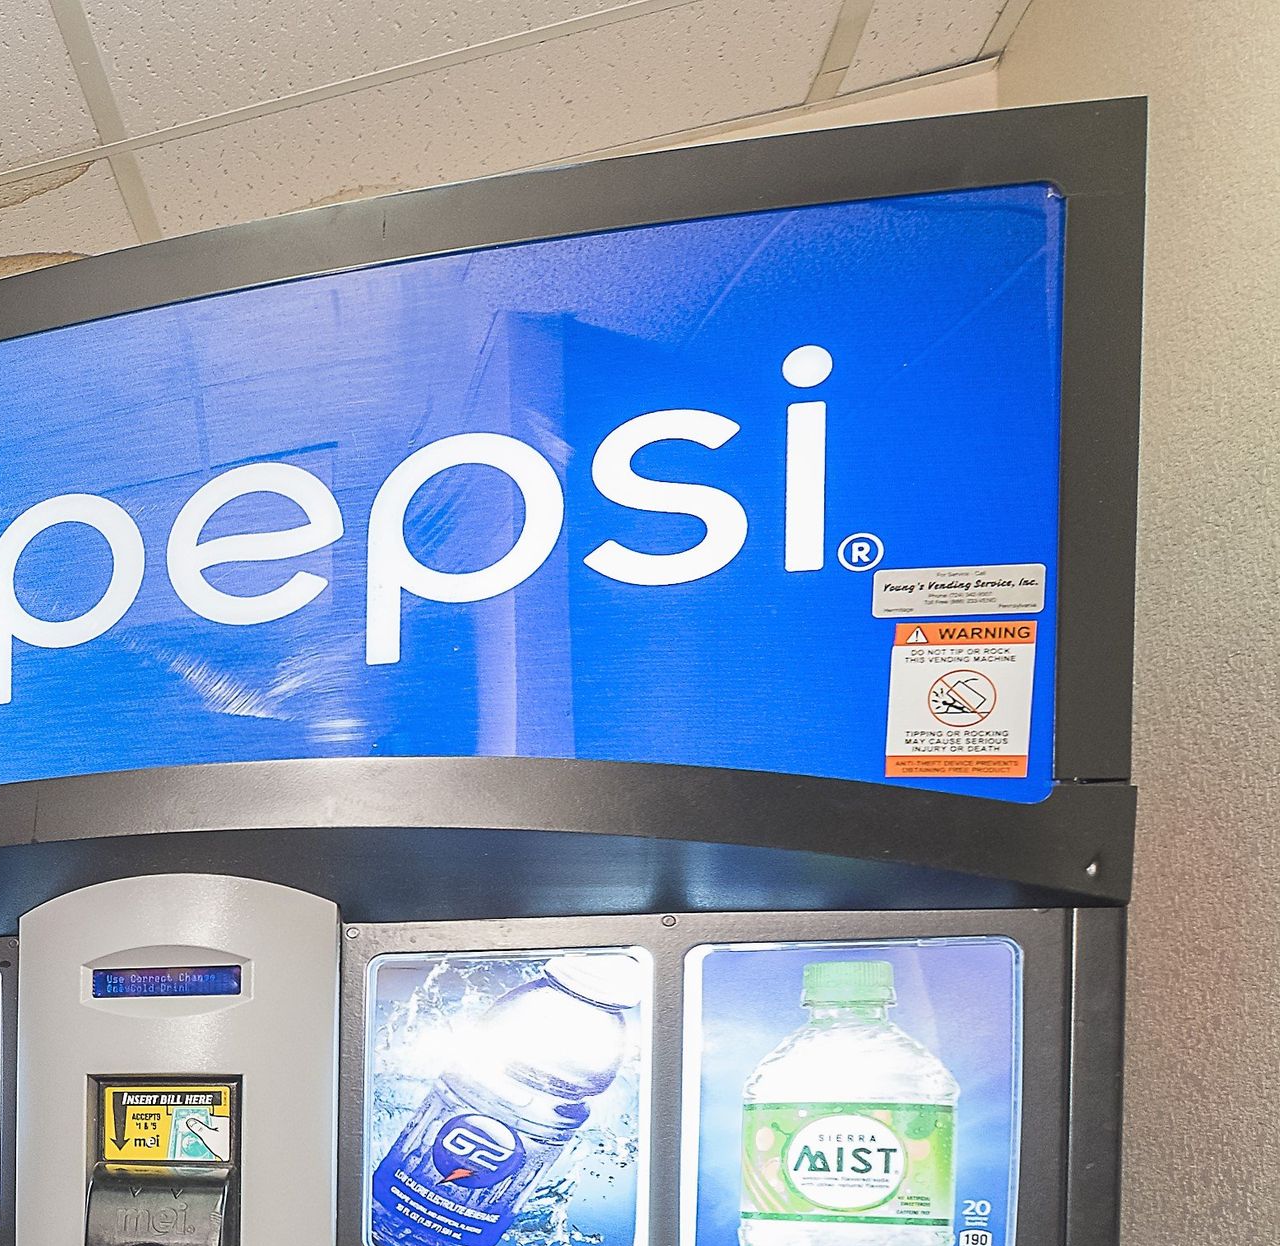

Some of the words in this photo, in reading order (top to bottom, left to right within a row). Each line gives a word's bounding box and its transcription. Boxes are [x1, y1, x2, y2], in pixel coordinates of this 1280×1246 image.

[928, 580, 972, 592] Vending
[1018, 577, 1039, 588] Inc.
[938, 626, 1031, 640] WARNING
[911, 649, 924, 657] DO
[984, 647, 1011, 655] ROCK
[973, 655, 1016, 663] MACHINE
[965, 737, 1009, 745] SERIOUS
[106, 974, 125, 984] Use
[130, 974, 173, 983] Correct
[179, 972, 216, 982] Change
[185, 1094, 214, 1105] HERE
[132, 1112, 161, 1121] ACCEPTS
[134, 1134, 160, 1149] mei
[819, 1134, 876, 1142] SIERRA
[442, 1127, 515, 1172] G2
[793, 1145, 898, 1174] MIST
[962, 1200, 991, 1216] 20
[964, 1233, 988, 1246] 190
